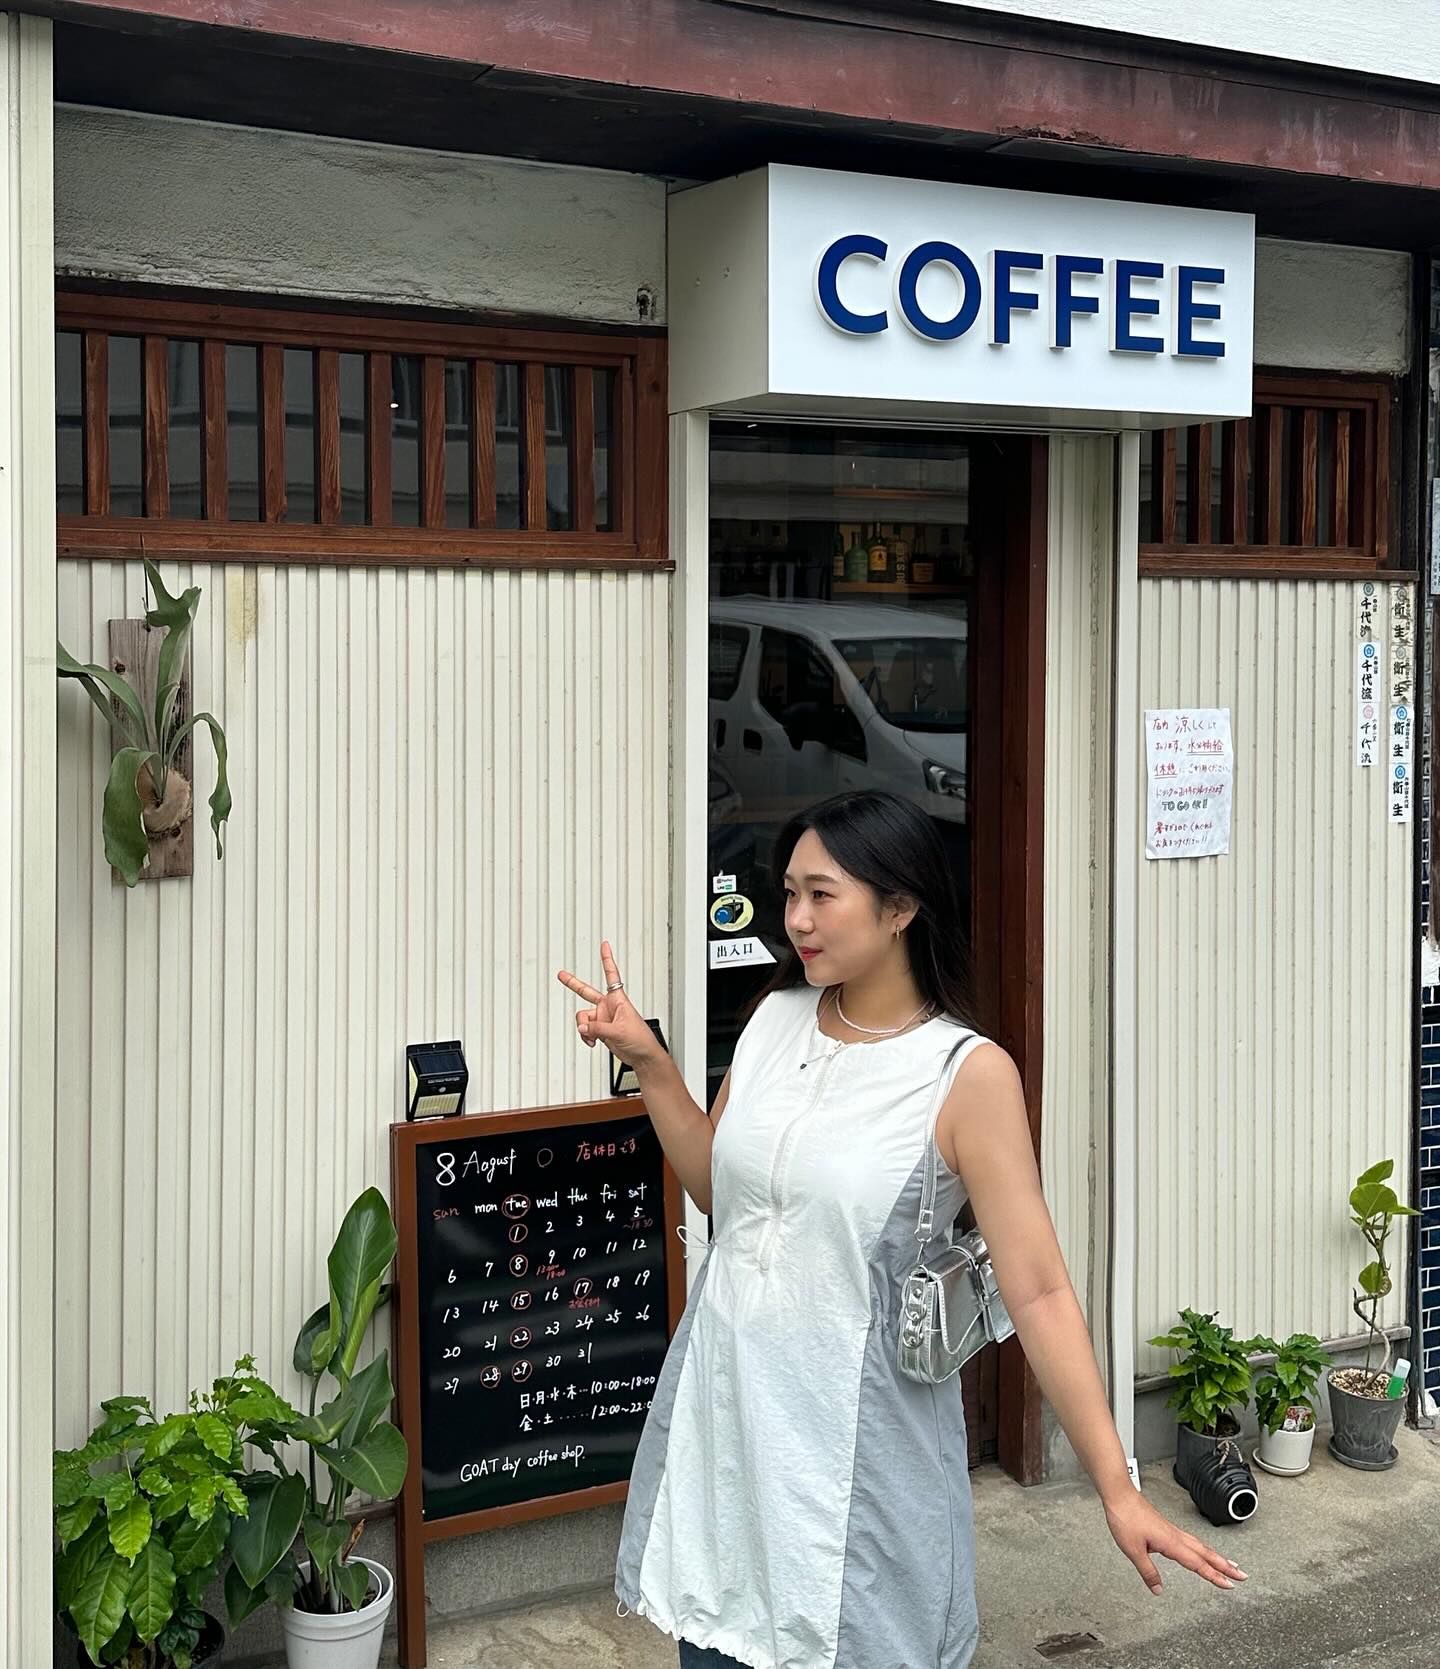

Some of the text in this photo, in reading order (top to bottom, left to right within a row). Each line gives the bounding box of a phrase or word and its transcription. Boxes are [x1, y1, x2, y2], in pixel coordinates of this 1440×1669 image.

[815, 234, 1225, 358] COFFEE
[1361, 660, 1373, 700] 千代流
[1393, 721, 1404, 757] 衛生
[1161, 801, 1175, 811] TO
[1177, 801, 1190, 811] GO
[1392, 781, 1404, 817] 衛生
[716, 943, 753, 958] 出入口
[436, 1152, 456, 1186] 8
[433, 1182, 648, 1221] sun mon tue wed thu fri sat
[513, 1205, 643, 1241] 1 2 3 4 5
[448, 1239, 647, 1284] 6 7 8 9 10 11 12
[443, 1270, 651, 1324] 13 14 15 16 17 18 19
[442, 1304, 650, 1359] 20 21 22 23 24 25 26
[444, 1342, 593, 1395] 27 28 29 30 31
[591, 1401, 653, 1420] 12:00~22:0
[460, 1458, 499, 1482] GOAT
[502, 1457, 521, 1478] day
[527, 1450, 558, 1467] coffee
